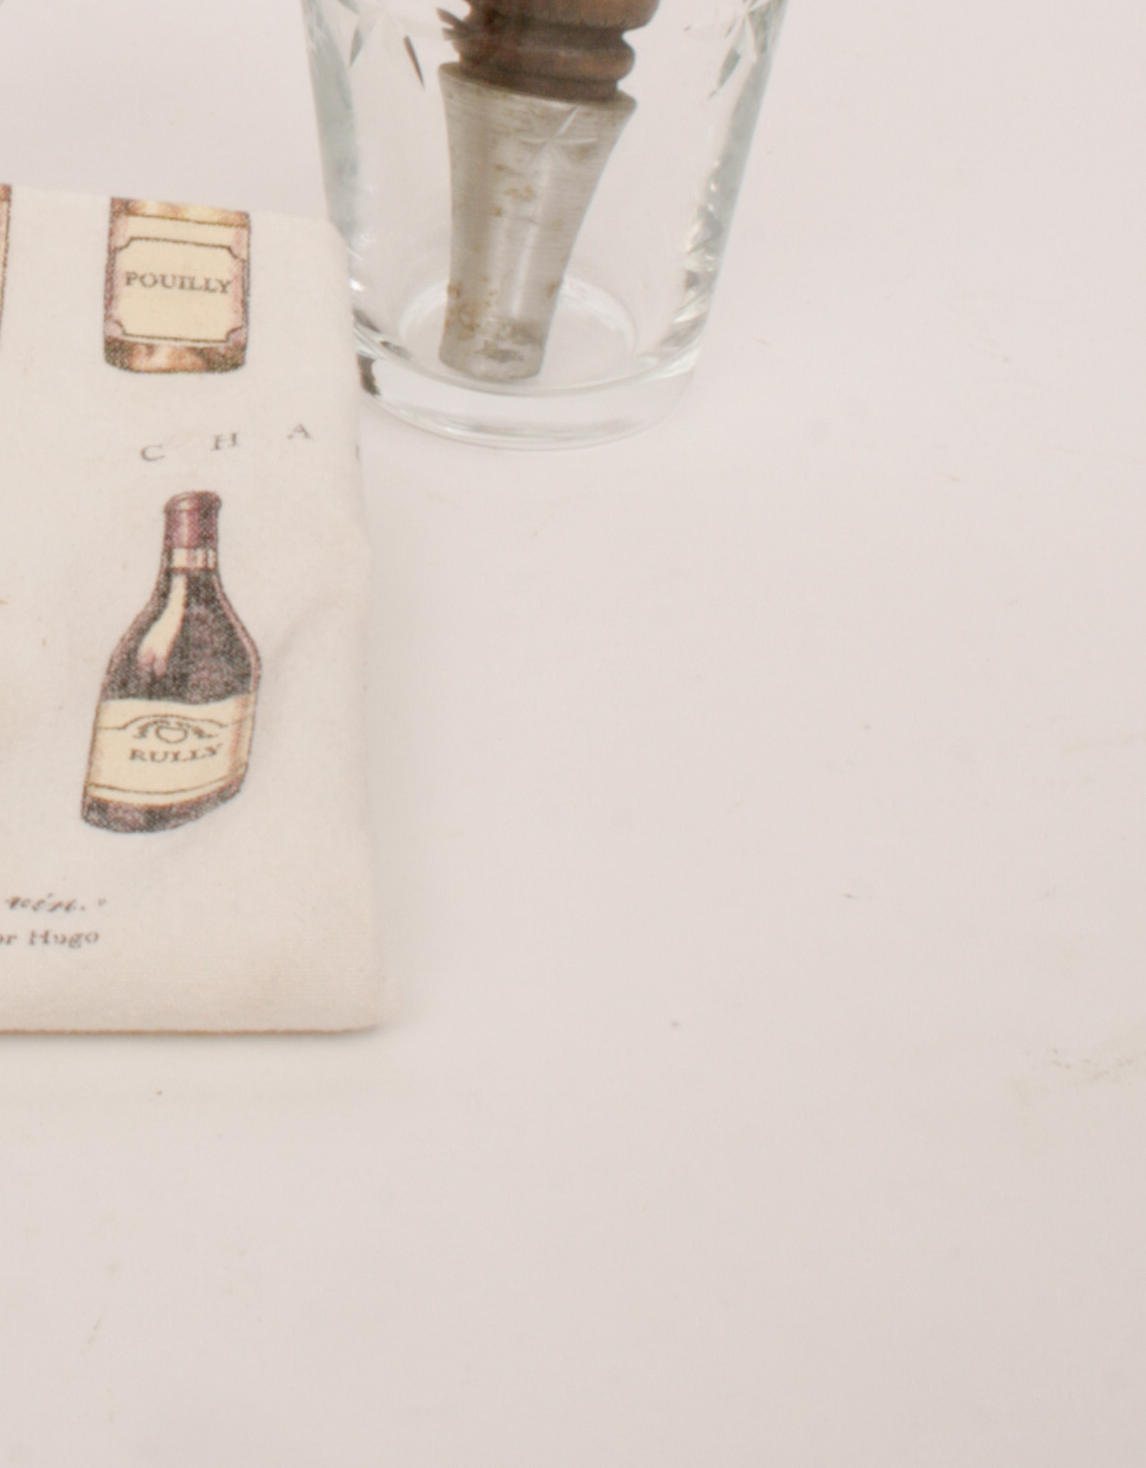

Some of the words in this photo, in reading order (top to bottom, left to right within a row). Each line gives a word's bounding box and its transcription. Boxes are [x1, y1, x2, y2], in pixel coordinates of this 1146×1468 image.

[124, 271, 233, 294] POUILLY
[129, 742, 224, 764] RULLY
[29, 930, 100, 949] Hugo
